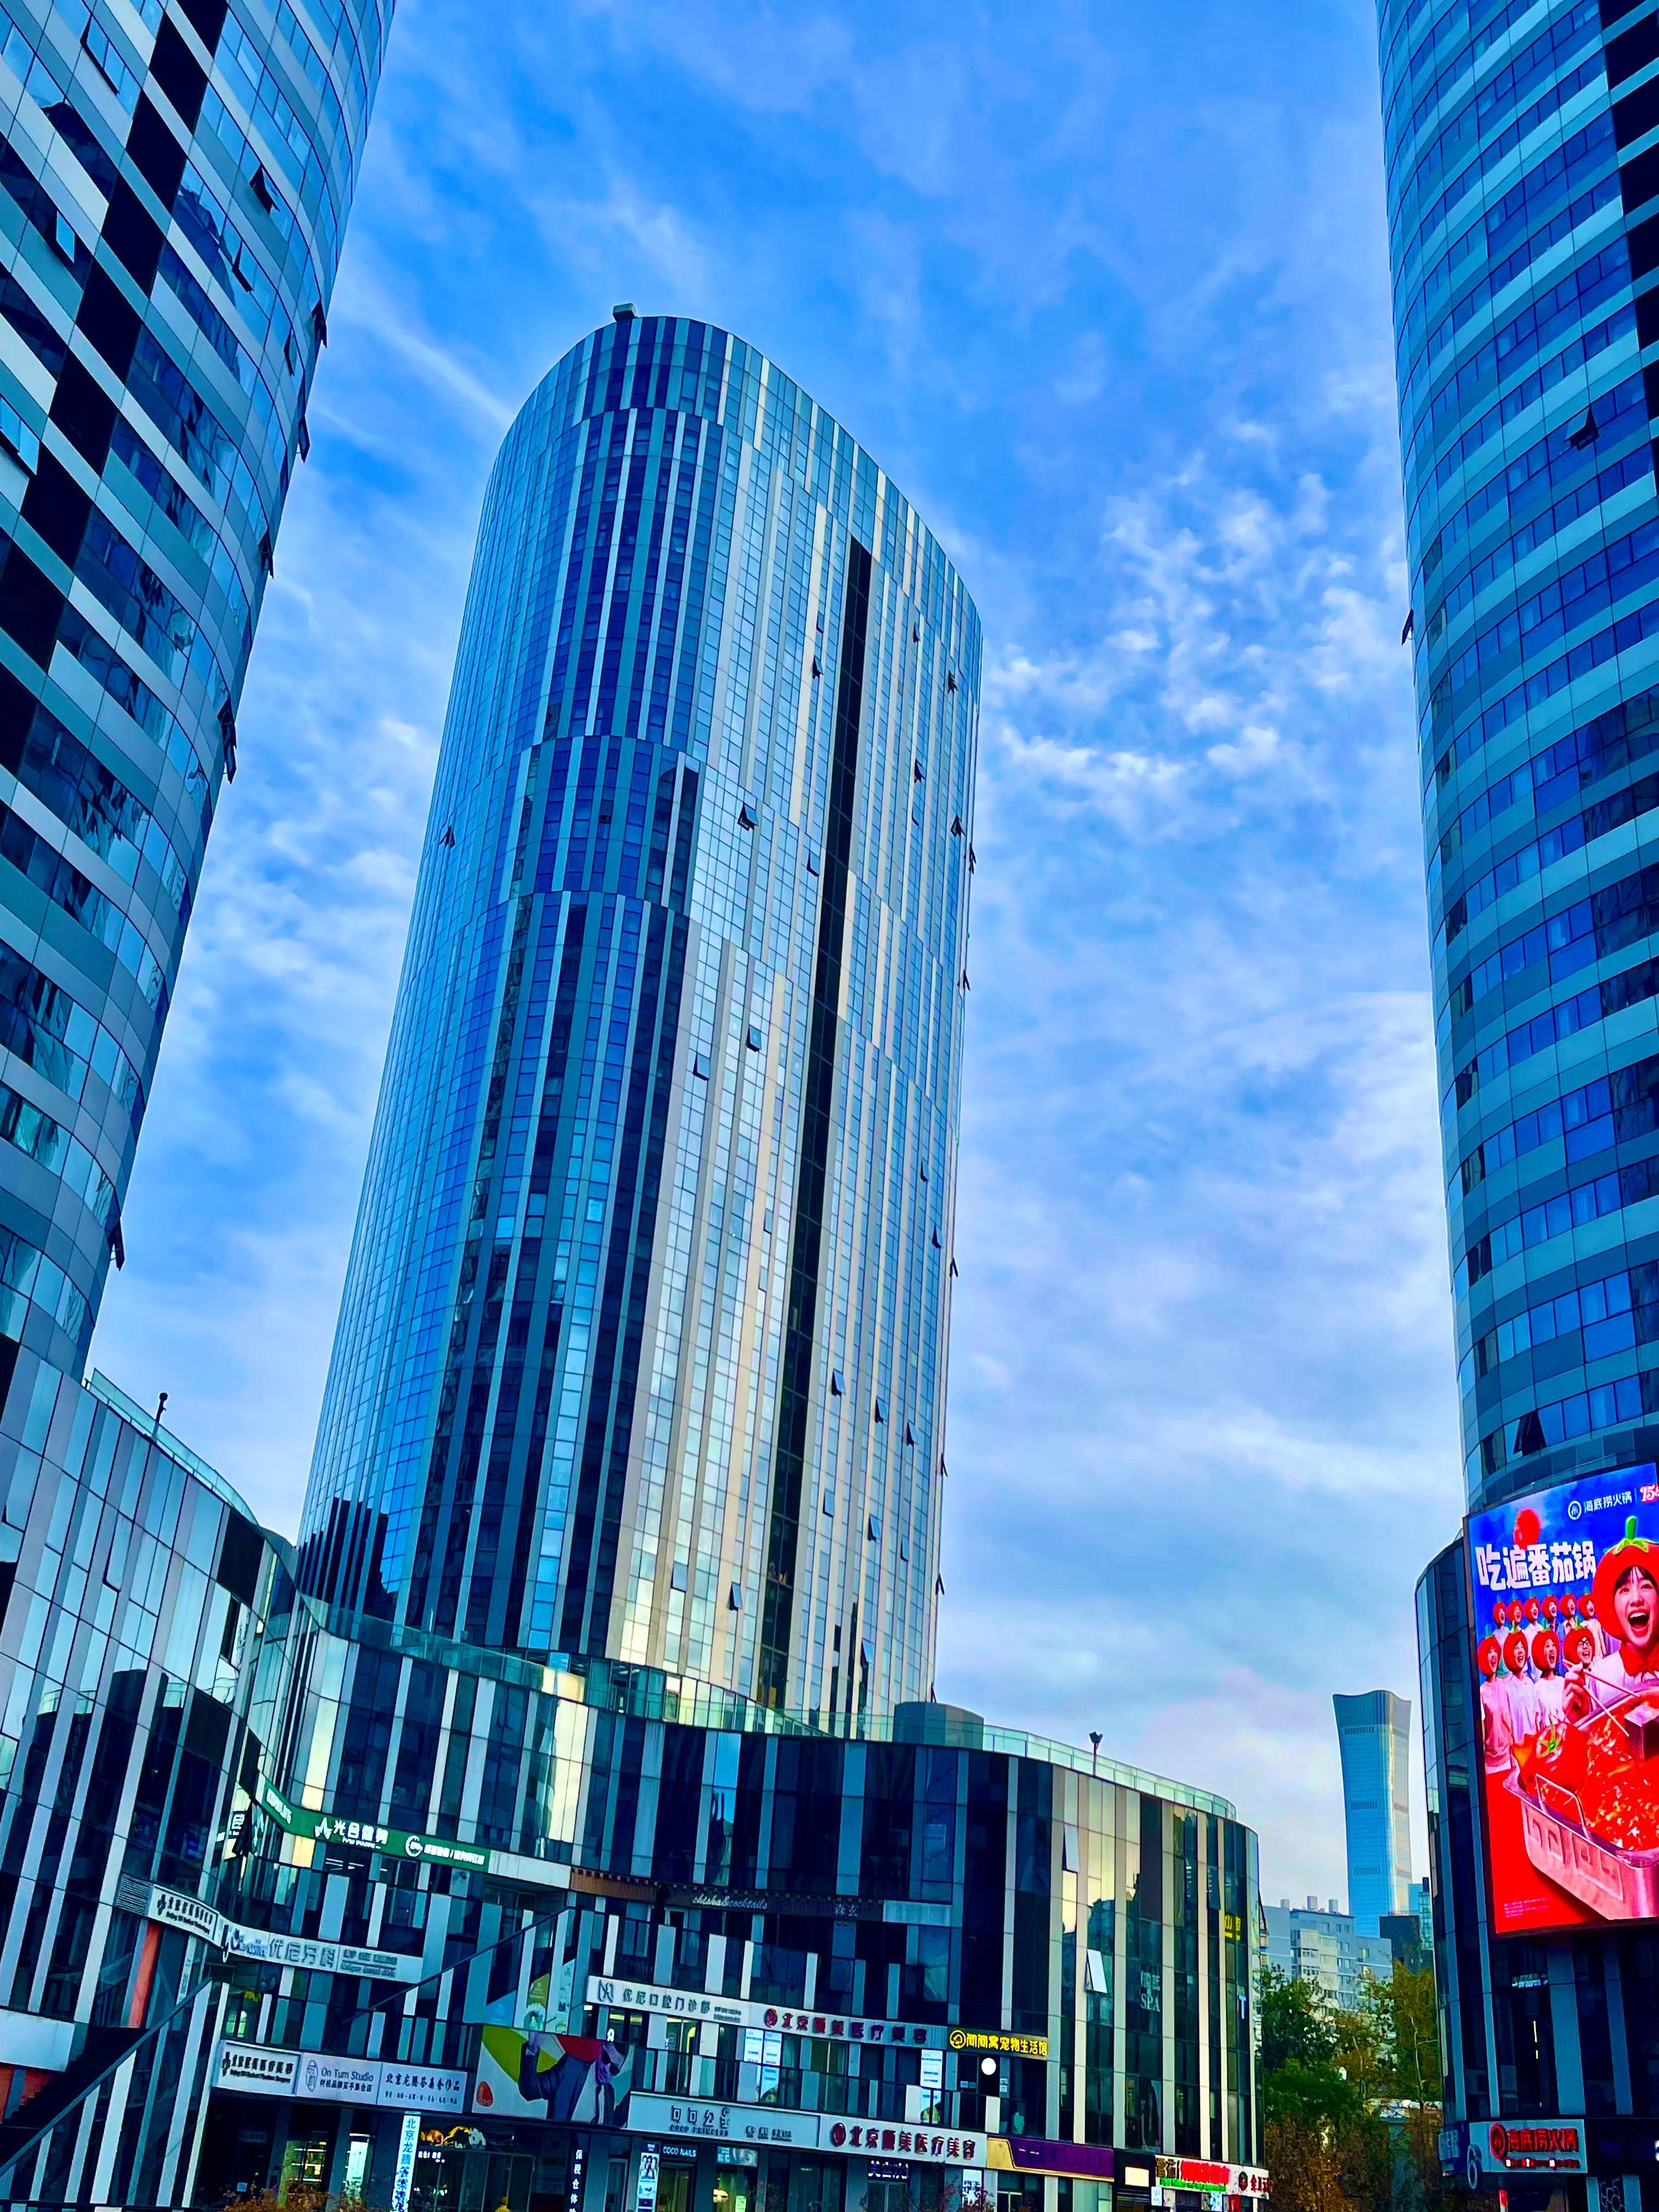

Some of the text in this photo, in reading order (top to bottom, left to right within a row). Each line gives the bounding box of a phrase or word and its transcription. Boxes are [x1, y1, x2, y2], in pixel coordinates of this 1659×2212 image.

[1584, 1491, 1632, 1513] 海底捞火锅
[1475, 1540, 1596, 1591] 吃遍番茄锅
[269, 1938, 336, 1968] 优尼牙科
[623, 1988, 711, 2014] 优尼口腔门诊部
[321, 2067, 331, 2076] On
[351, 2071, 374, 2082] Studio
[663, 2146, 679, 2155] COCO
[680, 2148, 697, 2157] NAILS
